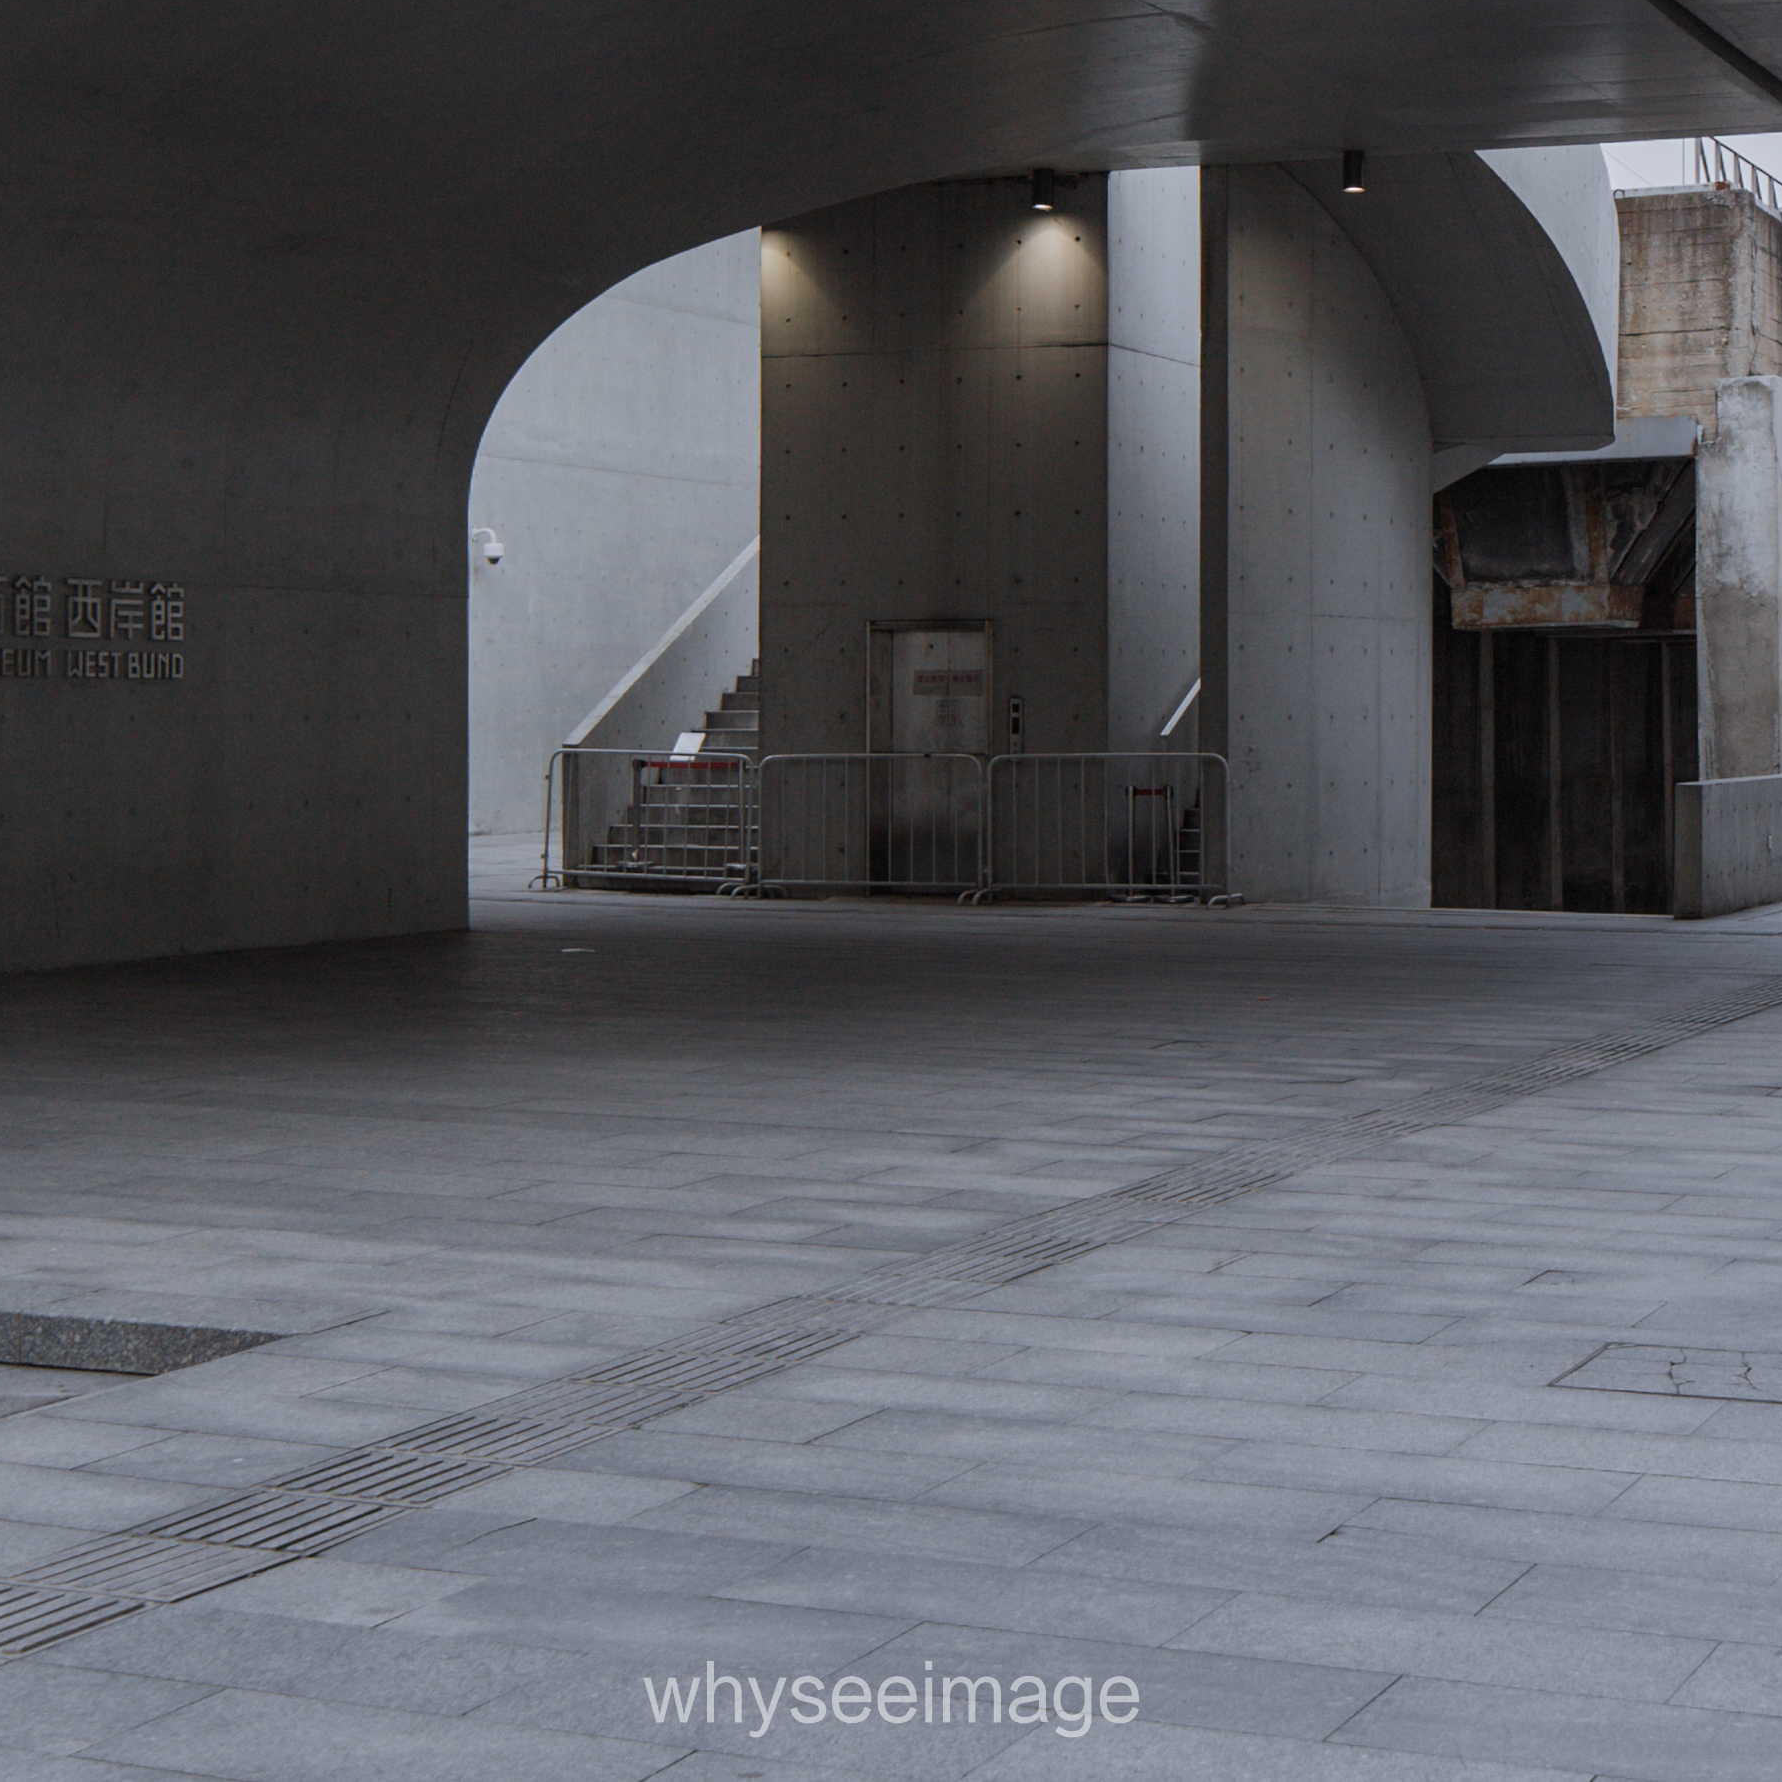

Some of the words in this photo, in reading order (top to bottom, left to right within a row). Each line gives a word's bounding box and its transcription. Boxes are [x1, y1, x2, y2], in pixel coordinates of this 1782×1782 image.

[65, 577, 185, 642] 西岸館
[66, 649, 122, 679] WEST
[127, 651, 185, 680] BUND
